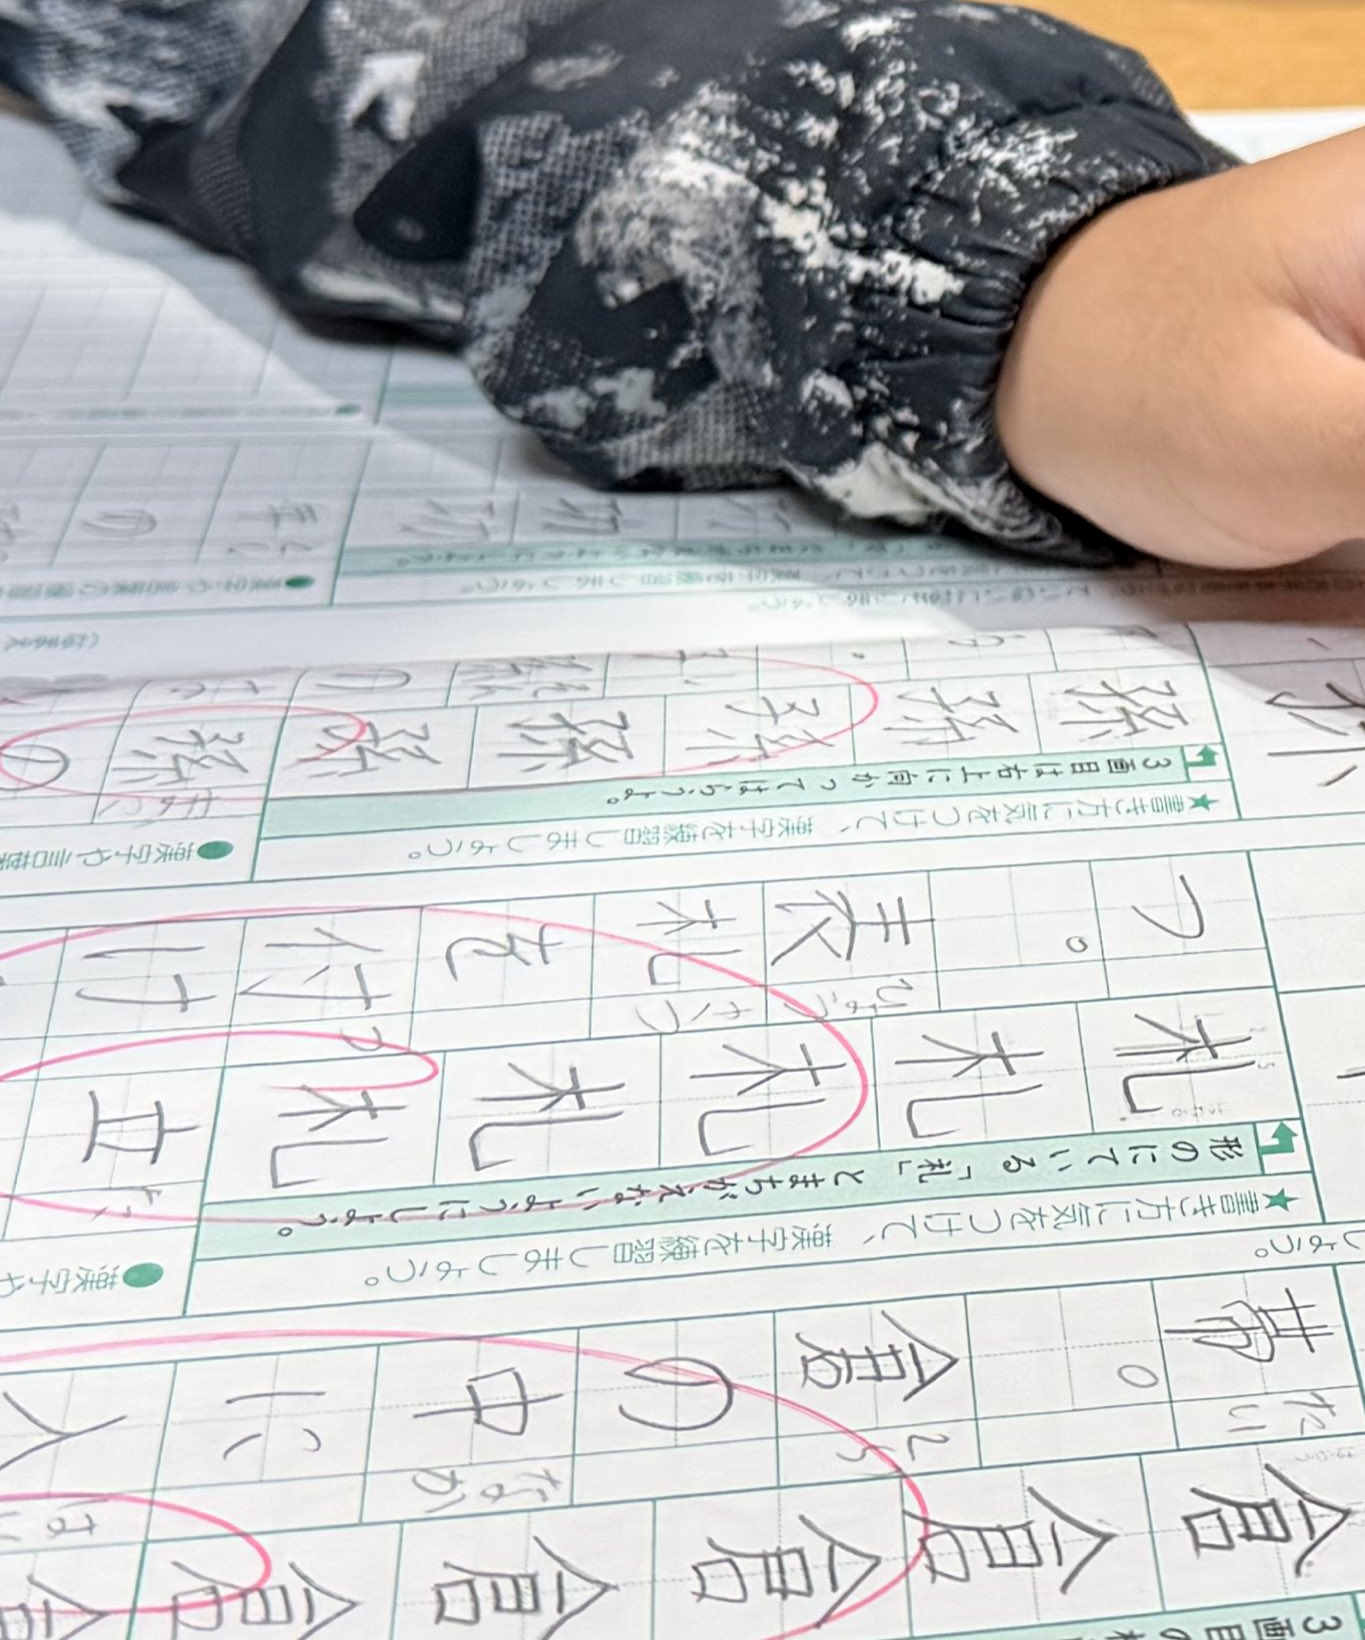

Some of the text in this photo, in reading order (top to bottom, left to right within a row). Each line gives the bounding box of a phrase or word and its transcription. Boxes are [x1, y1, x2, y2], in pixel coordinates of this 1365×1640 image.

[497, 711, 635, 773] 孫
[883, 687, 1019, 746] 孫
[1060, 680, 1189, 740] 孫
[308, 722, 442, 778] 孫
[605, 757, 1172, 805] 3画目は右上に向かってはらうよ。
[81, 1090, 201, 1165] 立
[271, 1014, 1256, 1189] 札 札 札 札 札
[364, 1188, 1259, 1286] 書き方に気をつけて、漢字を練習しましょう。
[902, 1486, 1118, 1596] 倉
[1181, 1463, 1352, 1578] 倉
[170, 1561, 366, 1640] 倉
[432, 1535, 620, 1640] 倉
[693, 1515, 882, 1630] 倉
